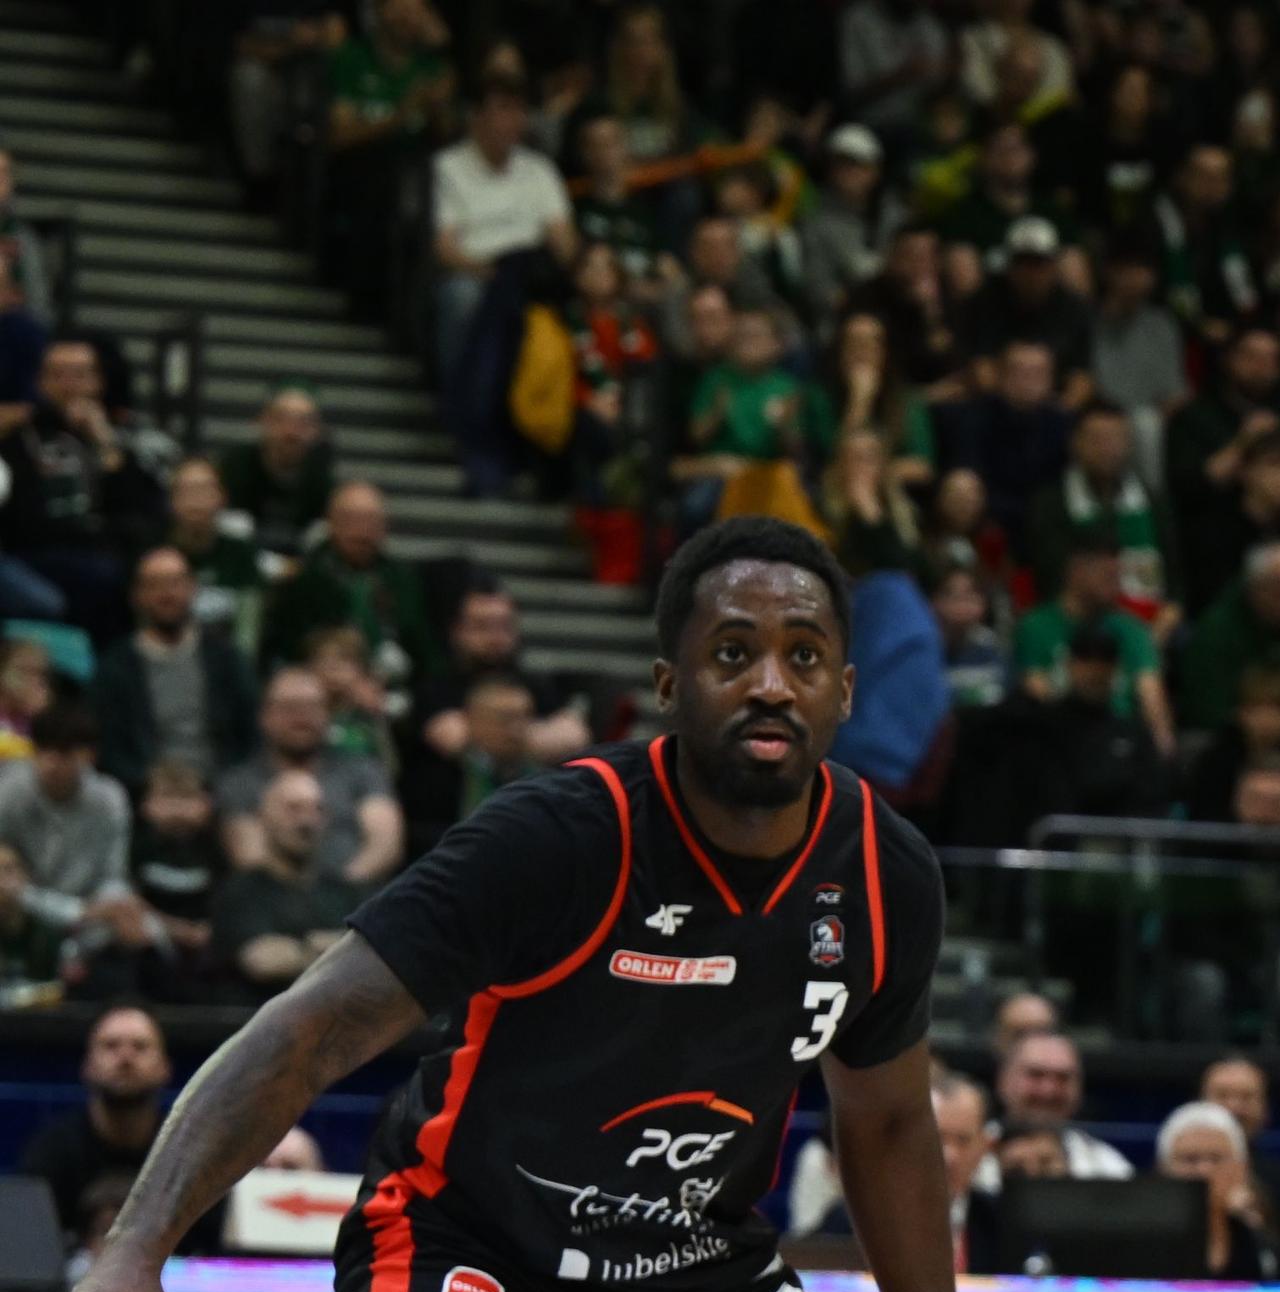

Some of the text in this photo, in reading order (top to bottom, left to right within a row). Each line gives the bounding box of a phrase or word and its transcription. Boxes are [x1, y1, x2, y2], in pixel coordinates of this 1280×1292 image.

[617, 956, 676, 980] ORLEN
[790, 980, 850, 1062] 3
[626, 1128, 736, 1171] PGE
